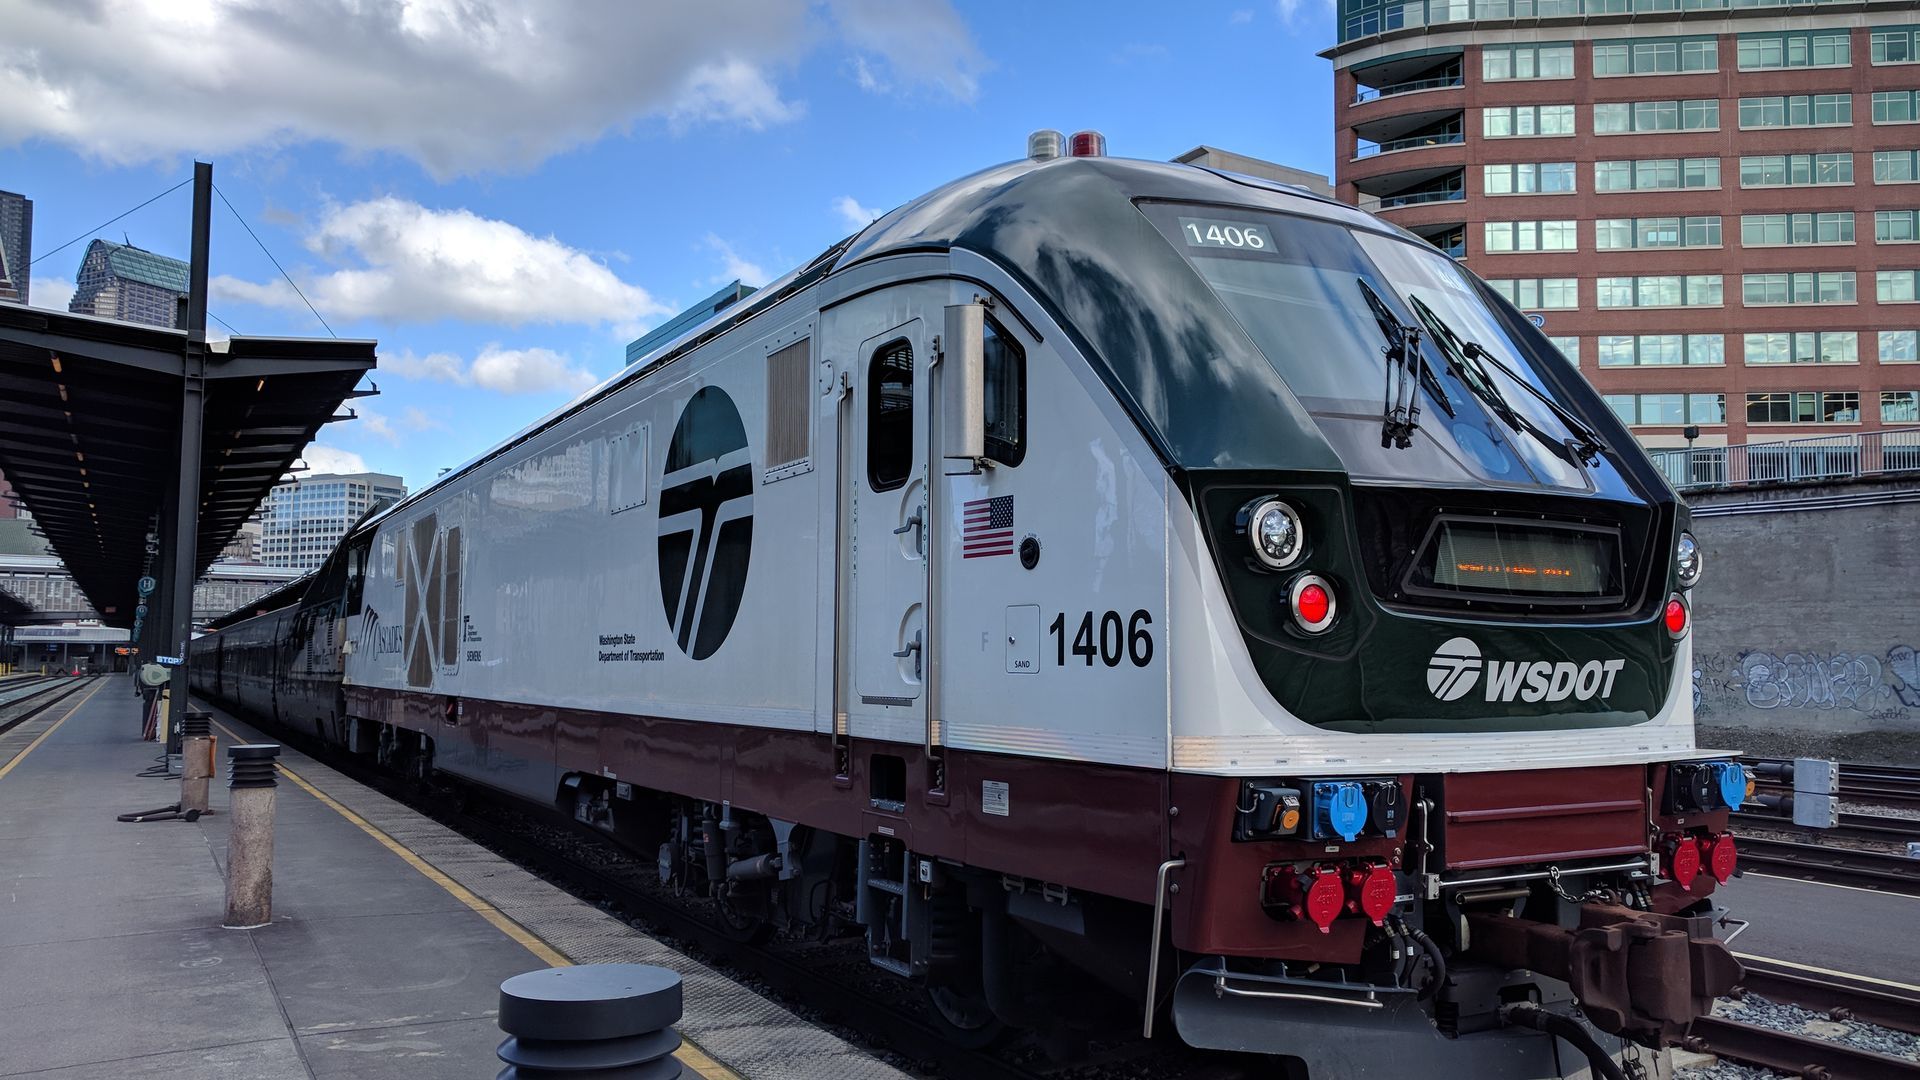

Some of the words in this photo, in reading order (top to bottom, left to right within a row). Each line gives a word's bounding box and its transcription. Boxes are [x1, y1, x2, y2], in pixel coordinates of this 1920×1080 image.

[1187, 223, 1264, 249] 1406
[599, 634, 623, 647] Washington
[624, 633, 635, 644] State
[981, 631, 989, 652] F
[1050, 609, 1153, 668] 1406
[599, 650, 623, 664] Department
[624, 650, 629, 661] of
[630, 649, 664, 663] Transportation
[1015, 660, 1030, 668] SAND
[1485, 658, 1626, 704] WSDOT
